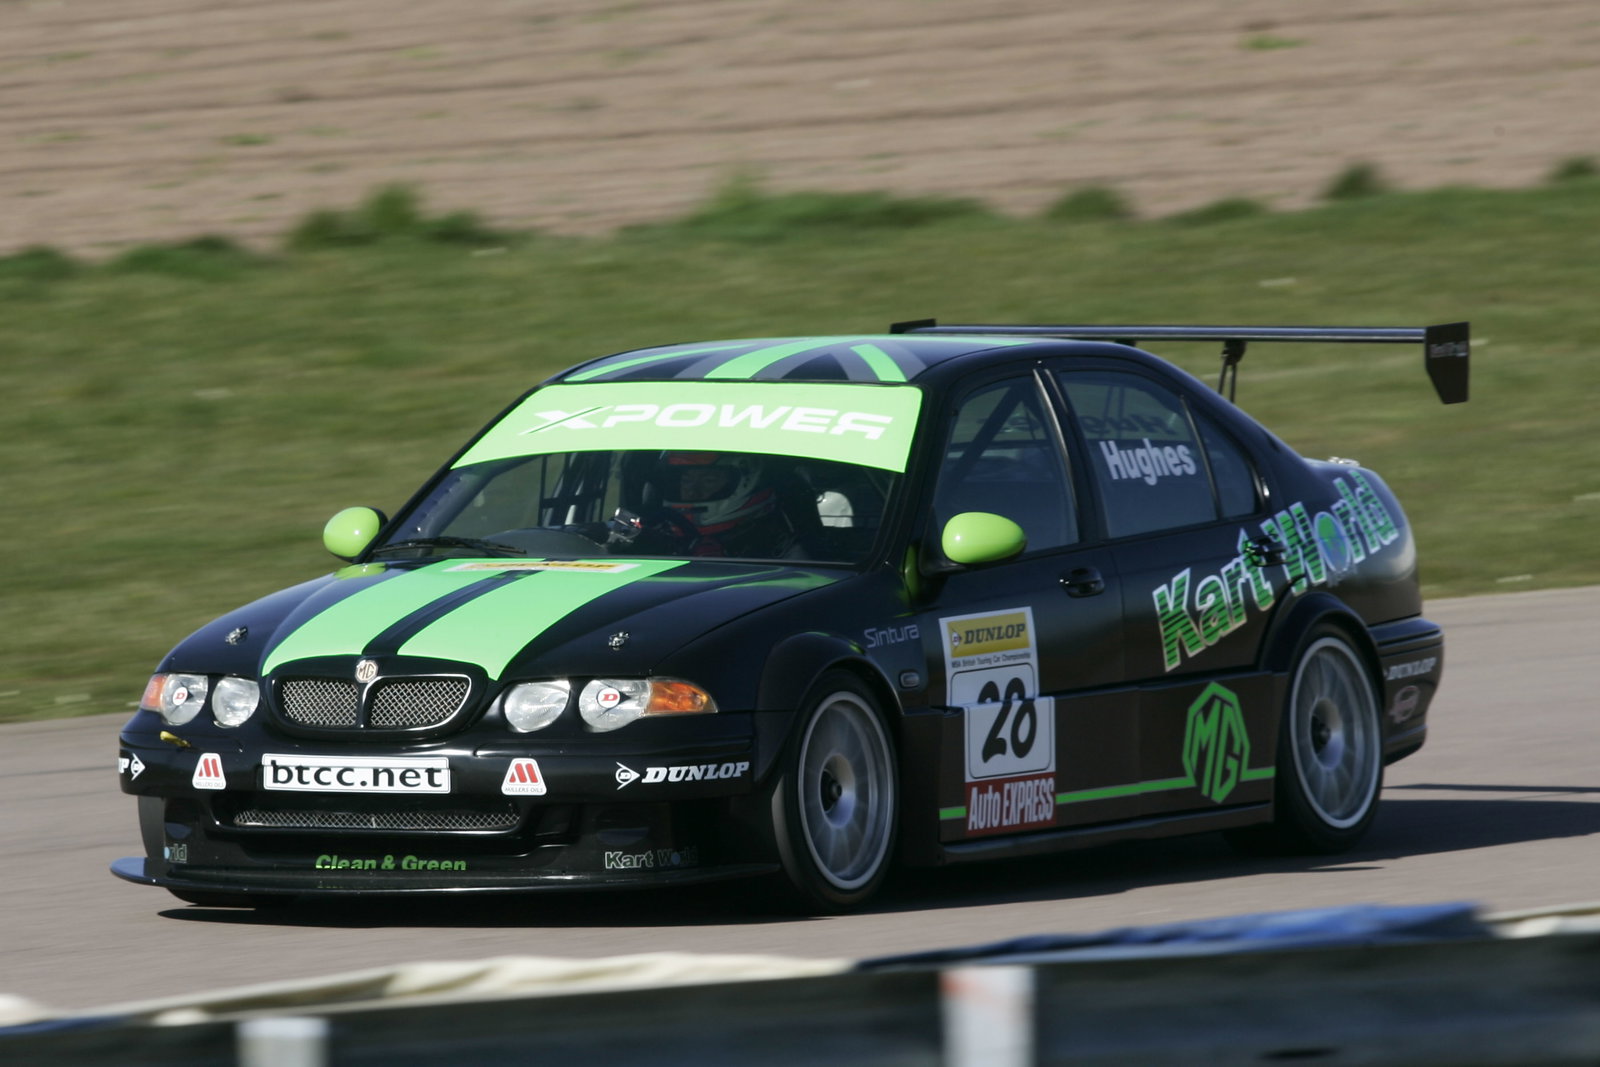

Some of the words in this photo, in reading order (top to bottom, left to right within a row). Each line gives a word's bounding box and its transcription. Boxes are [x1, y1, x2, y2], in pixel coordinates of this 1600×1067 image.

[518, 403, 893, 440] XPOWER
[1100, 438, 1196, 486] Hughes
[1152, 528, 1274, 672] Kart
[1260, 470, 1399, 597] World
[864, 624, 920, 648] Sintura
[964, 623, 1026, 645] DUNLOP
[993, 655, 1001, 663] Car
[358, 663, 375, 679] MG
[271, 760, 443, 787] btcc.net
[641, 762, 750, 784] DUNLOP
[968, 785, 999, 831] Auto
[1002, 778, 1055, 826] EXPRESS
[315, 854, 377, 870] Clean
[381, 854, 396, 870] &
[401, 854, 467, 871] Green
[604, 850, 654, 870] Kart
